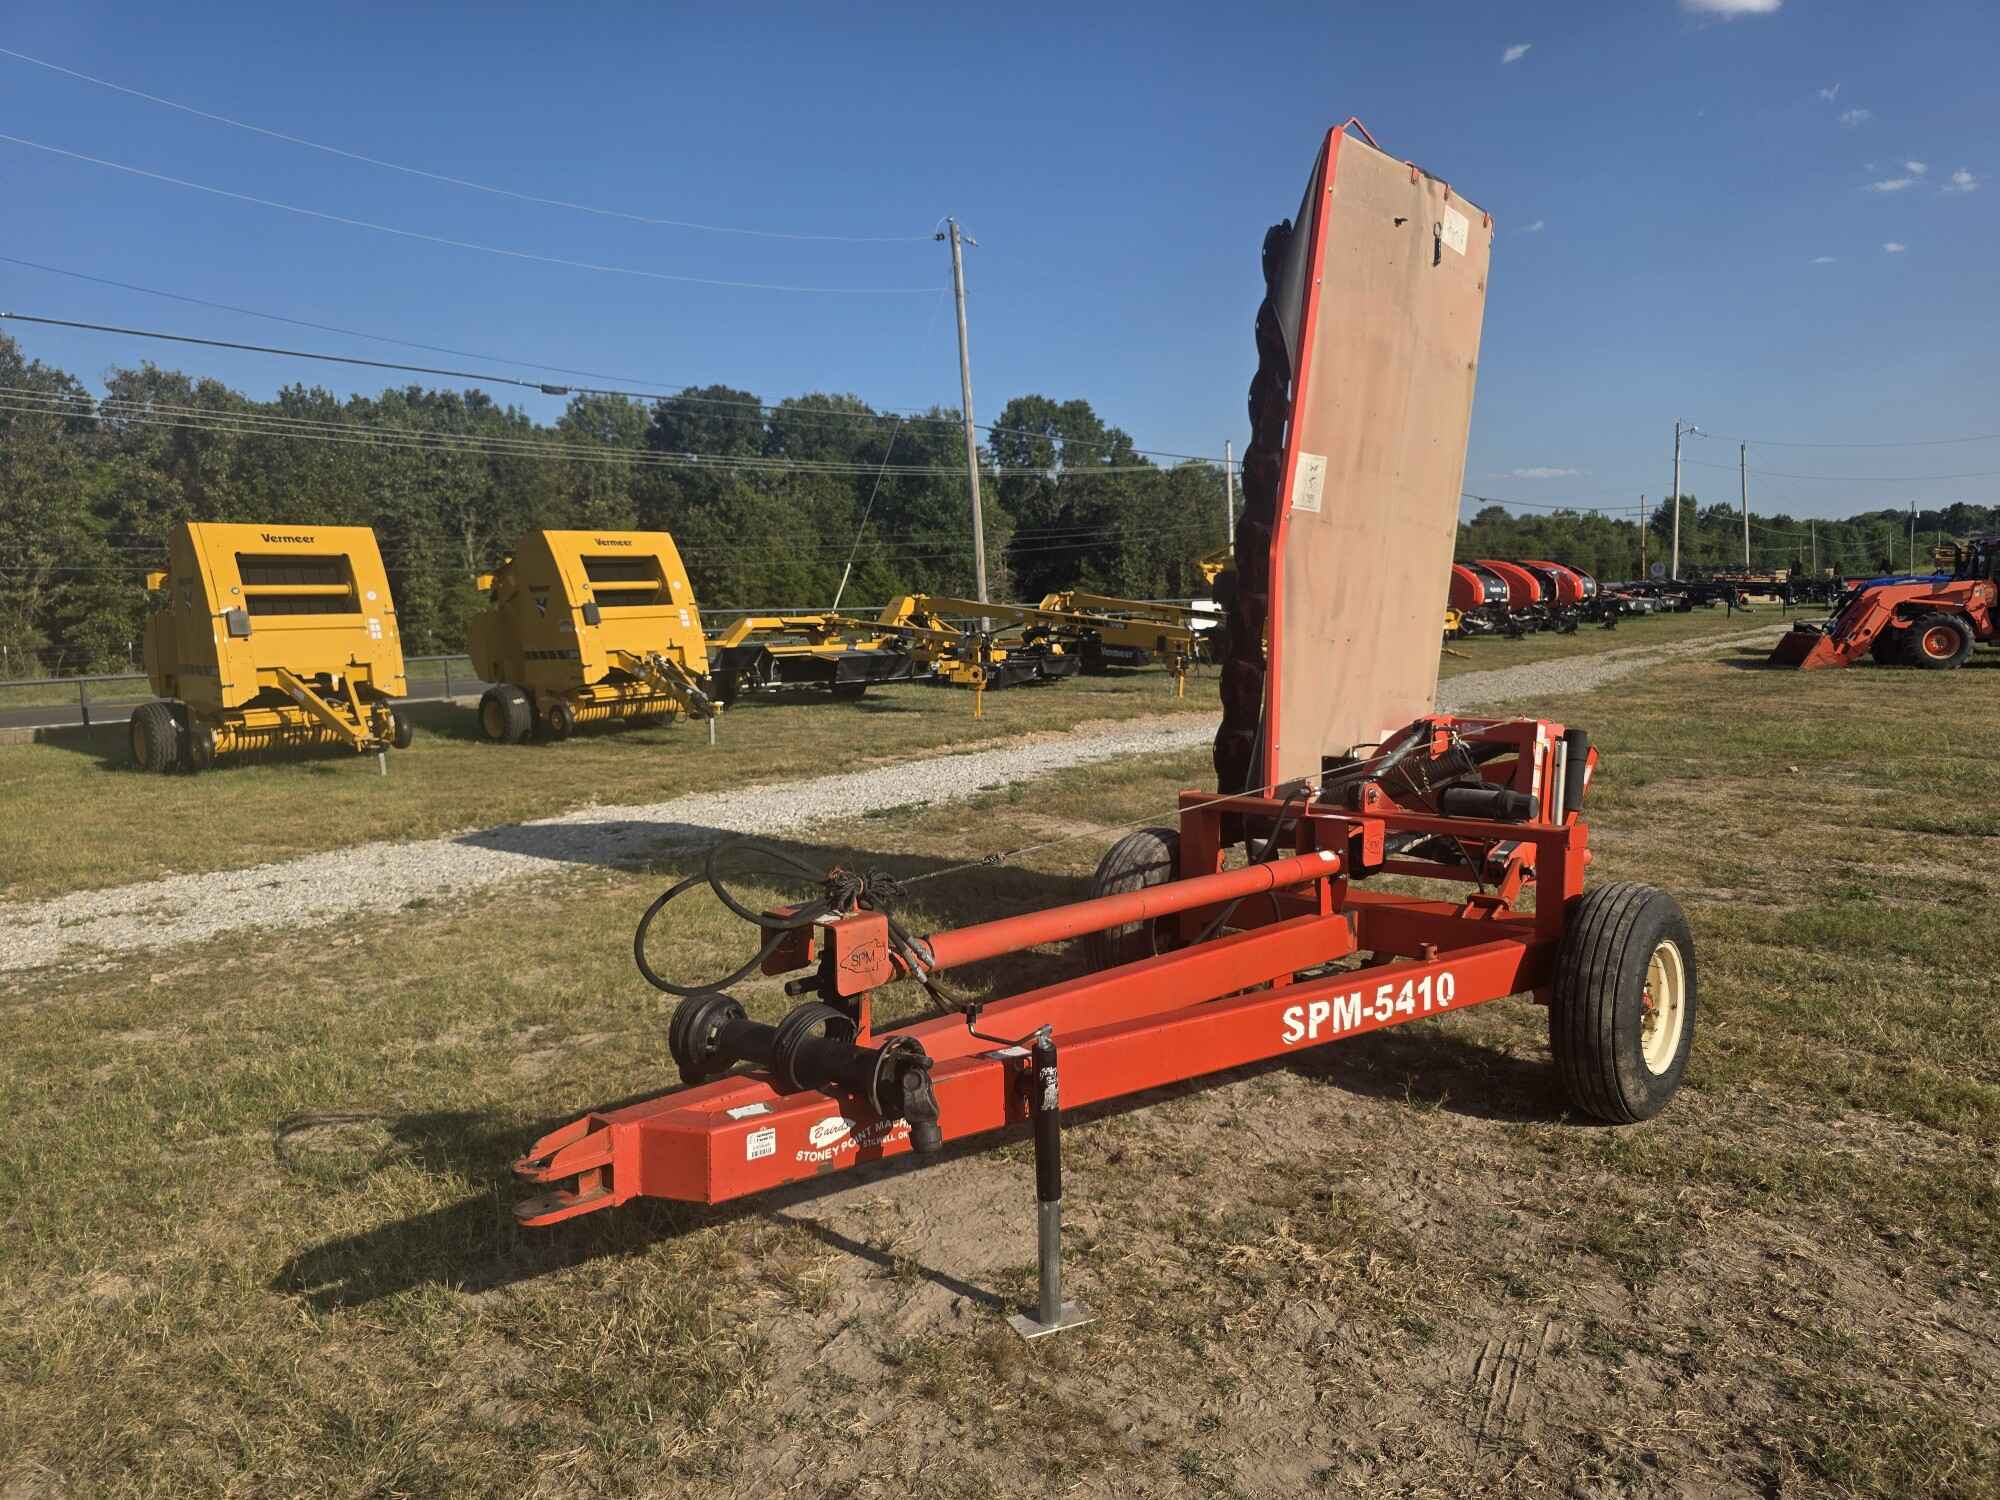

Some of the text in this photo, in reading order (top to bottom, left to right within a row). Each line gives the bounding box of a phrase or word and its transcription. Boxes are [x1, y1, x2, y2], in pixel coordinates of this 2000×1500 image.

[261, 533, 315, 543] Vermeer
[594, 538, 632, 547] Vermeer
[1281, 971, 1455, 1045] SPM-5410
[795, 1144, 840, 1162] STONEY
